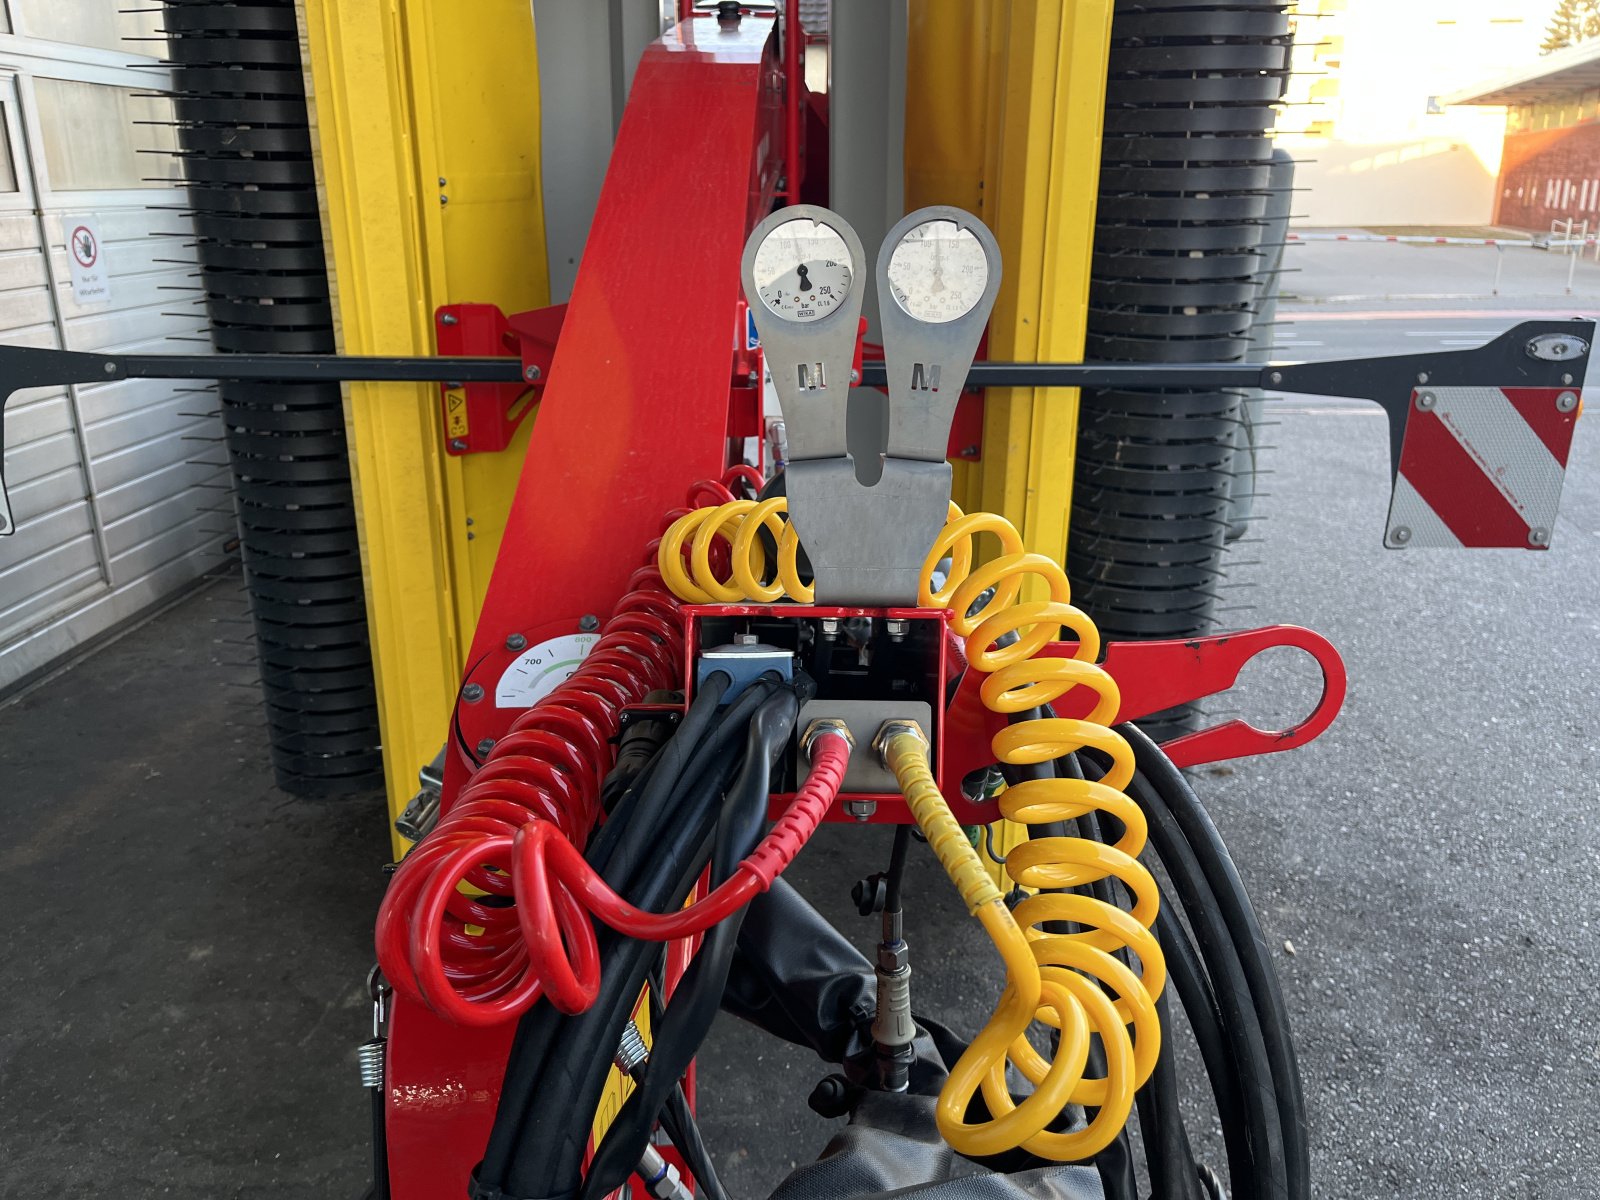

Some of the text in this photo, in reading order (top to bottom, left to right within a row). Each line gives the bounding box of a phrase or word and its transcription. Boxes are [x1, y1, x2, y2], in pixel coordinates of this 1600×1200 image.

[947, 240, 960, 249] 150
[825, 259, 838, 268] 200
[902, 261, 911, 271] 50
[961, 264, 974, 274] 200
[777, 290, 783, 299] 0
[819, 285, 831, 295] 250
[950, 289, 962, 300] 250
